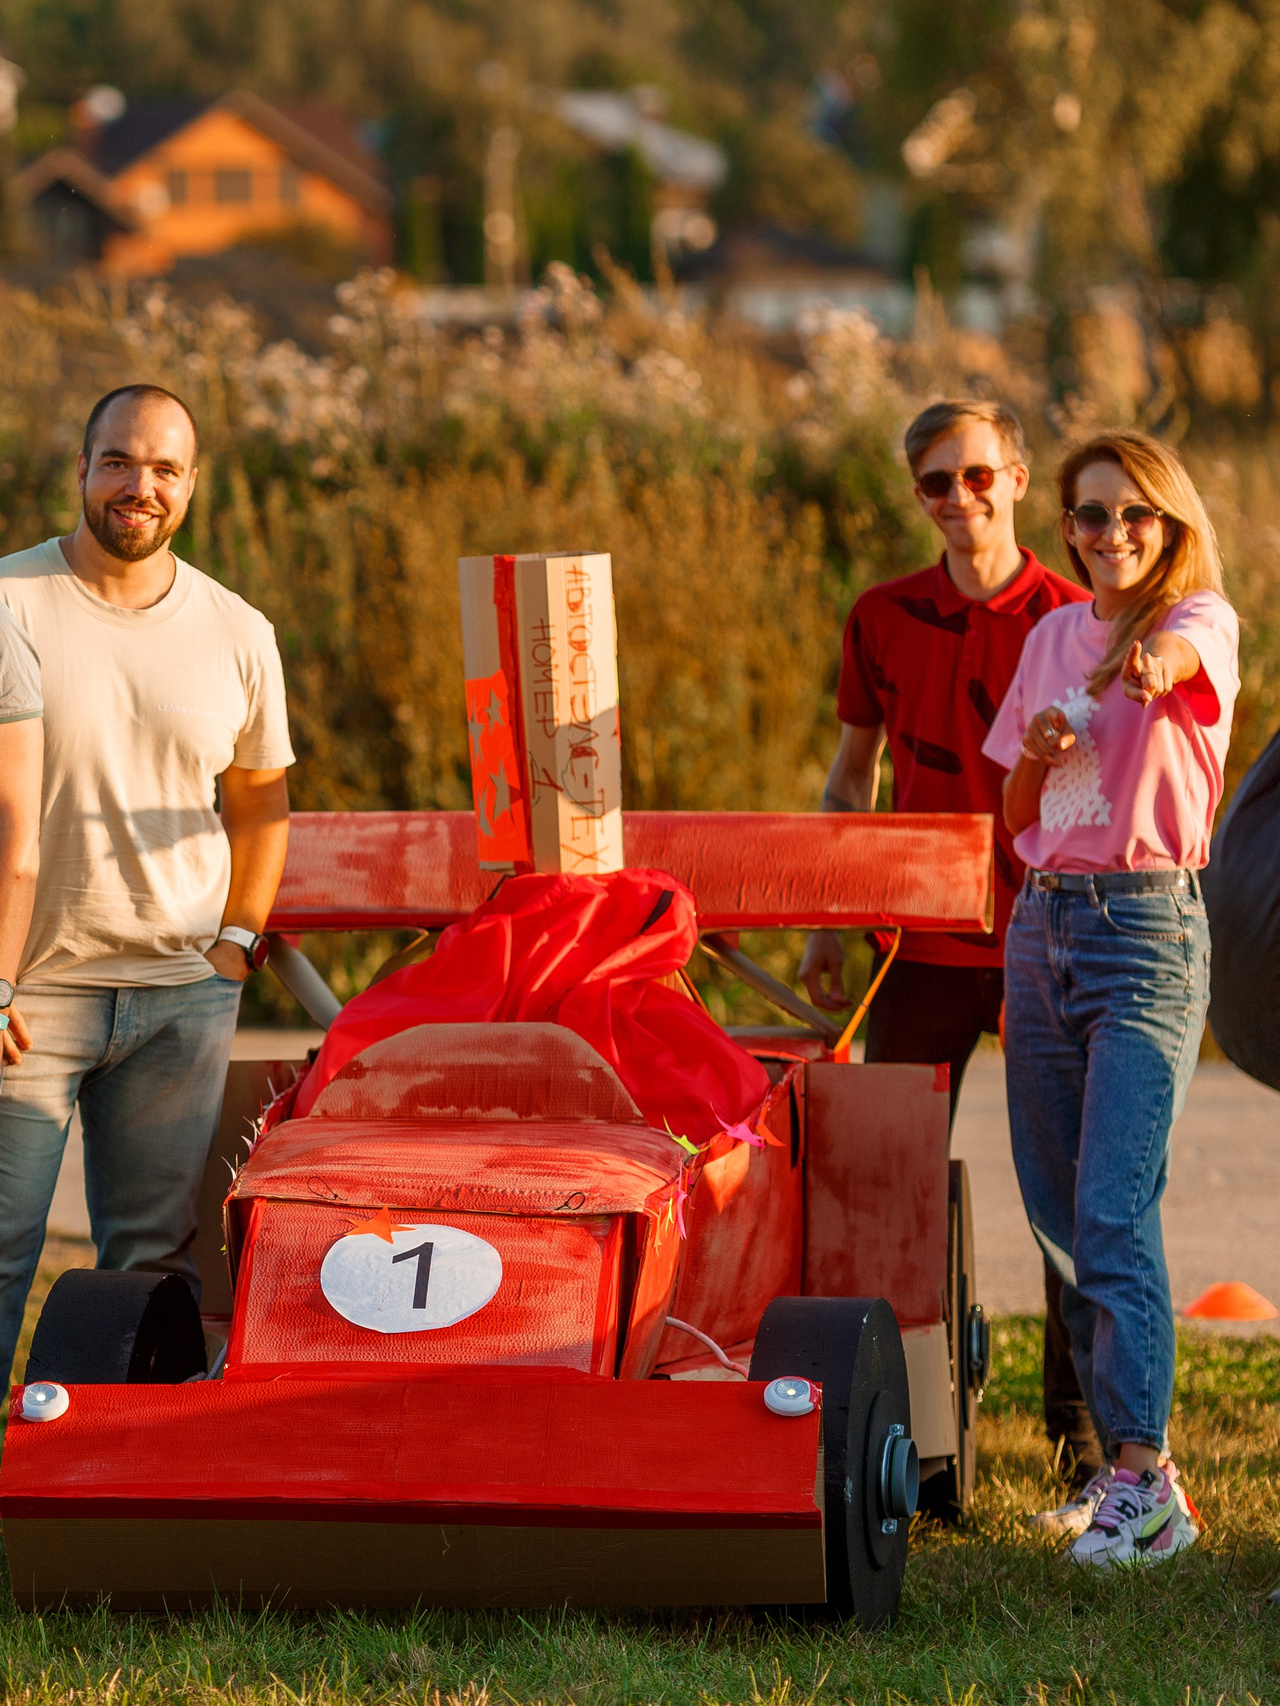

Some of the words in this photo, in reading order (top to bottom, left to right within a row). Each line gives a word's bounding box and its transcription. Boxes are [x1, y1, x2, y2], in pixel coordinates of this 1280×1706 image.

[531, 617, 560, 739] НОМЕР
[530, 759, 564, 800] 1
[392, 1241, 434, 1310] 1
